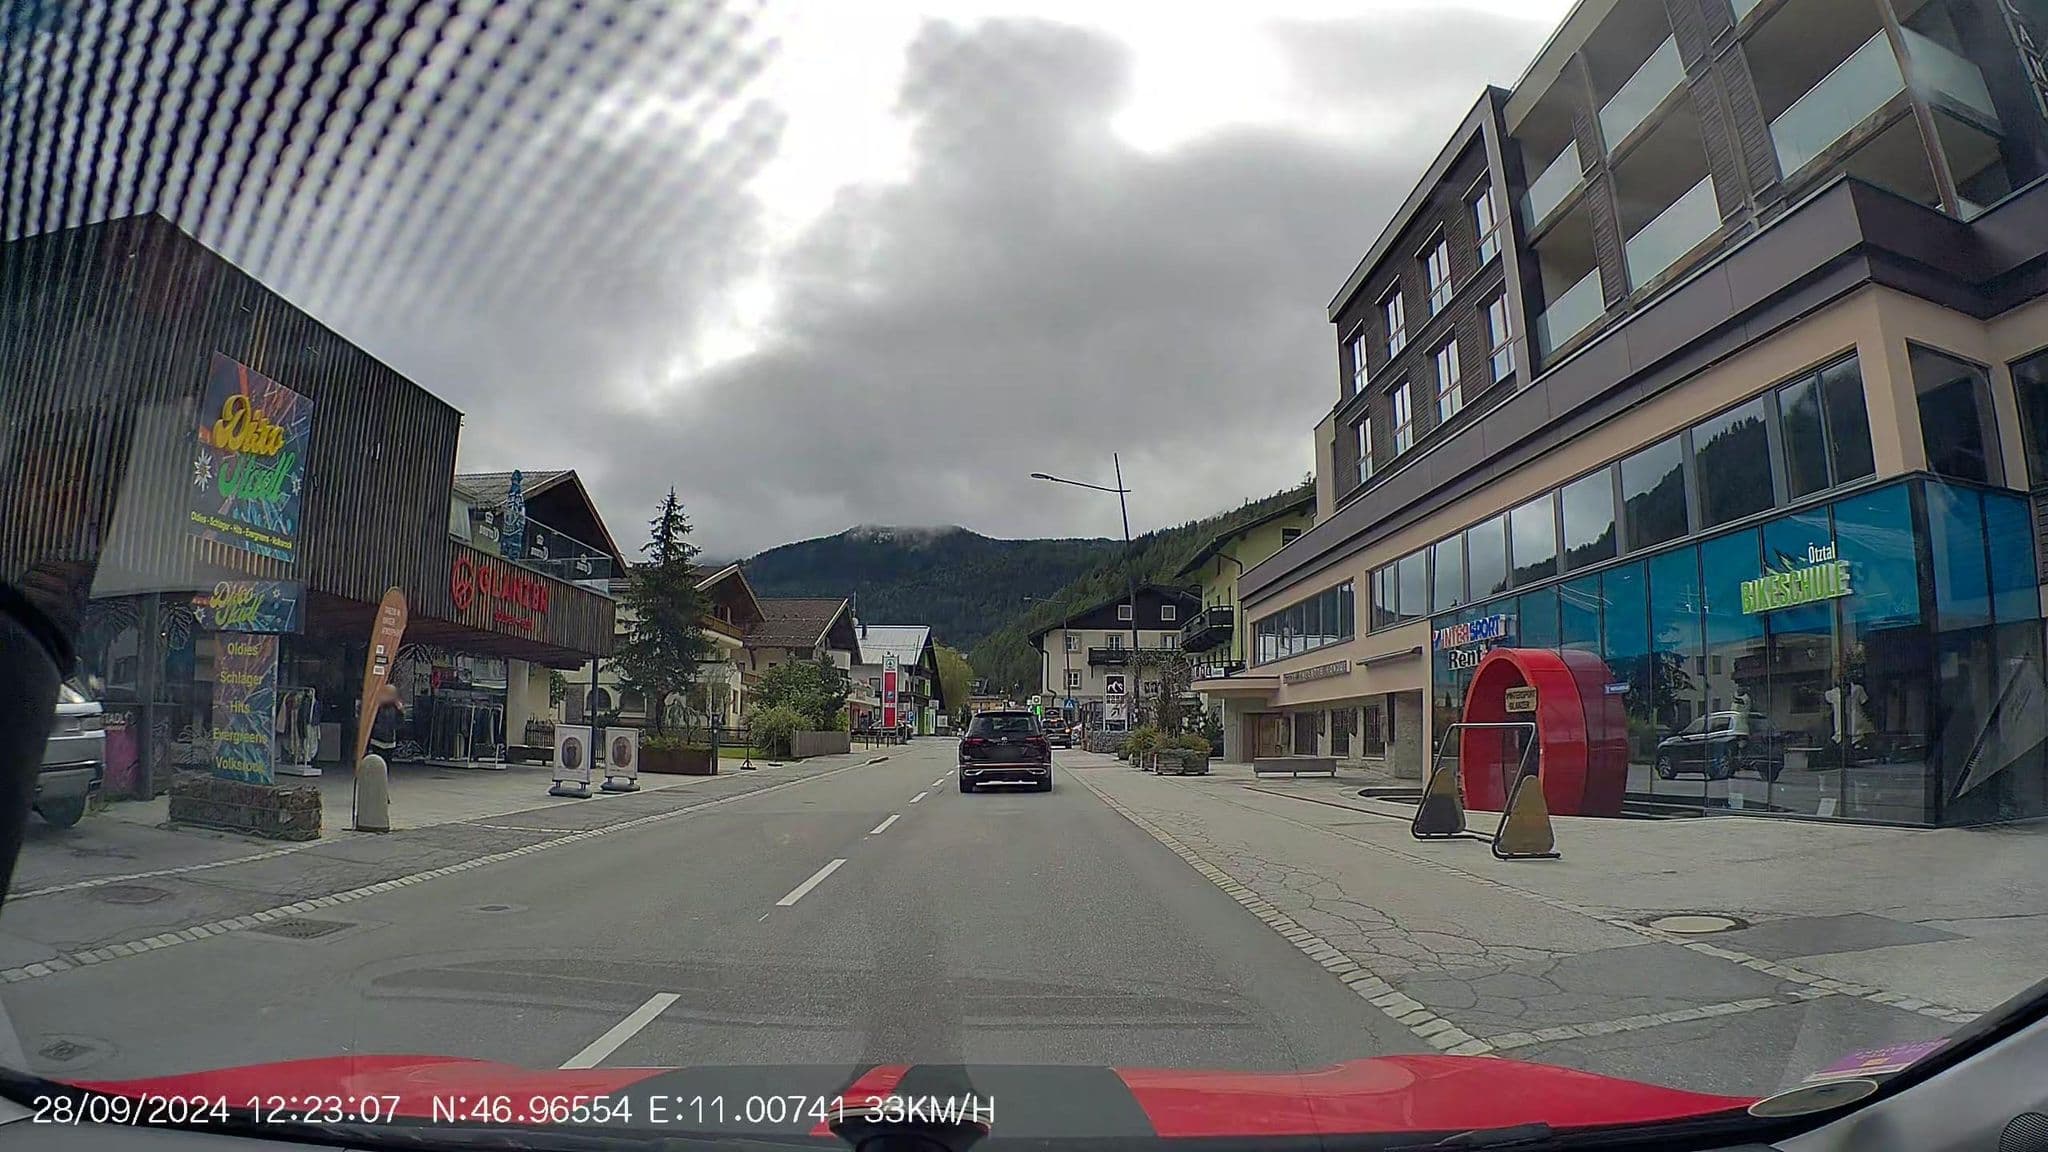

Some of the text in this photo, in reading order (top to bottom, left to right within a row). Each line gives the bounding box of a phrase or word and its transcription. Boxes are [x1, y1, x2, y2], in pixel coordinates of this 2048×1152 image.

[479, 565, 548, 614] GLANZER
[1741, 560, 1853, 614] BIKESCHULE
[1440, 614, 1506, 649] INTERSPORT
[227, 642, 259, 656] Oldies
[1448, 646, 1483, 670] Rent
[220, 671, 263, 687] Schlager
[229, 700, 251, 714] Hits
[212, 727, 268, 745] Evergreens
